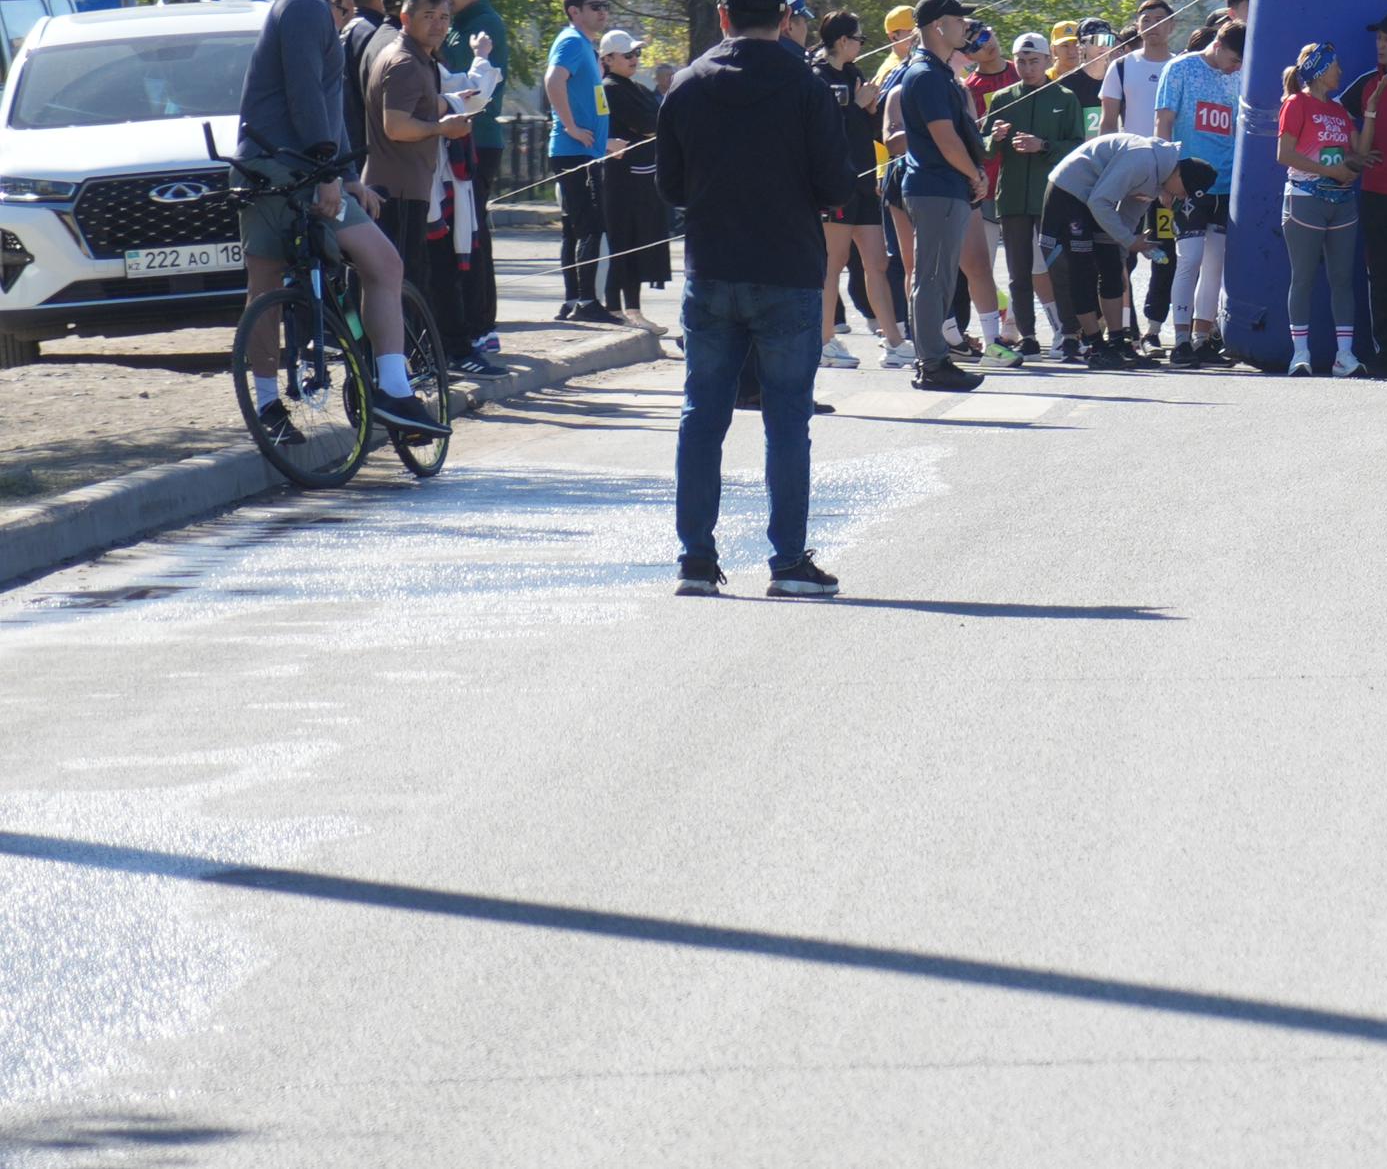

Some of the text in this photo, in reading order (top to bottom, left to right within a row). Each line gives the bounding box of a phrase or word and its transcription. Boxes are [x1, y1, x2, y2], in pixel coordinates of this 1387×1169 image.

[1199, 107, 1230, 129] 100
[128, 263, 140, 271] KZ
[145, 245, 242, 270] 222 AO 18
